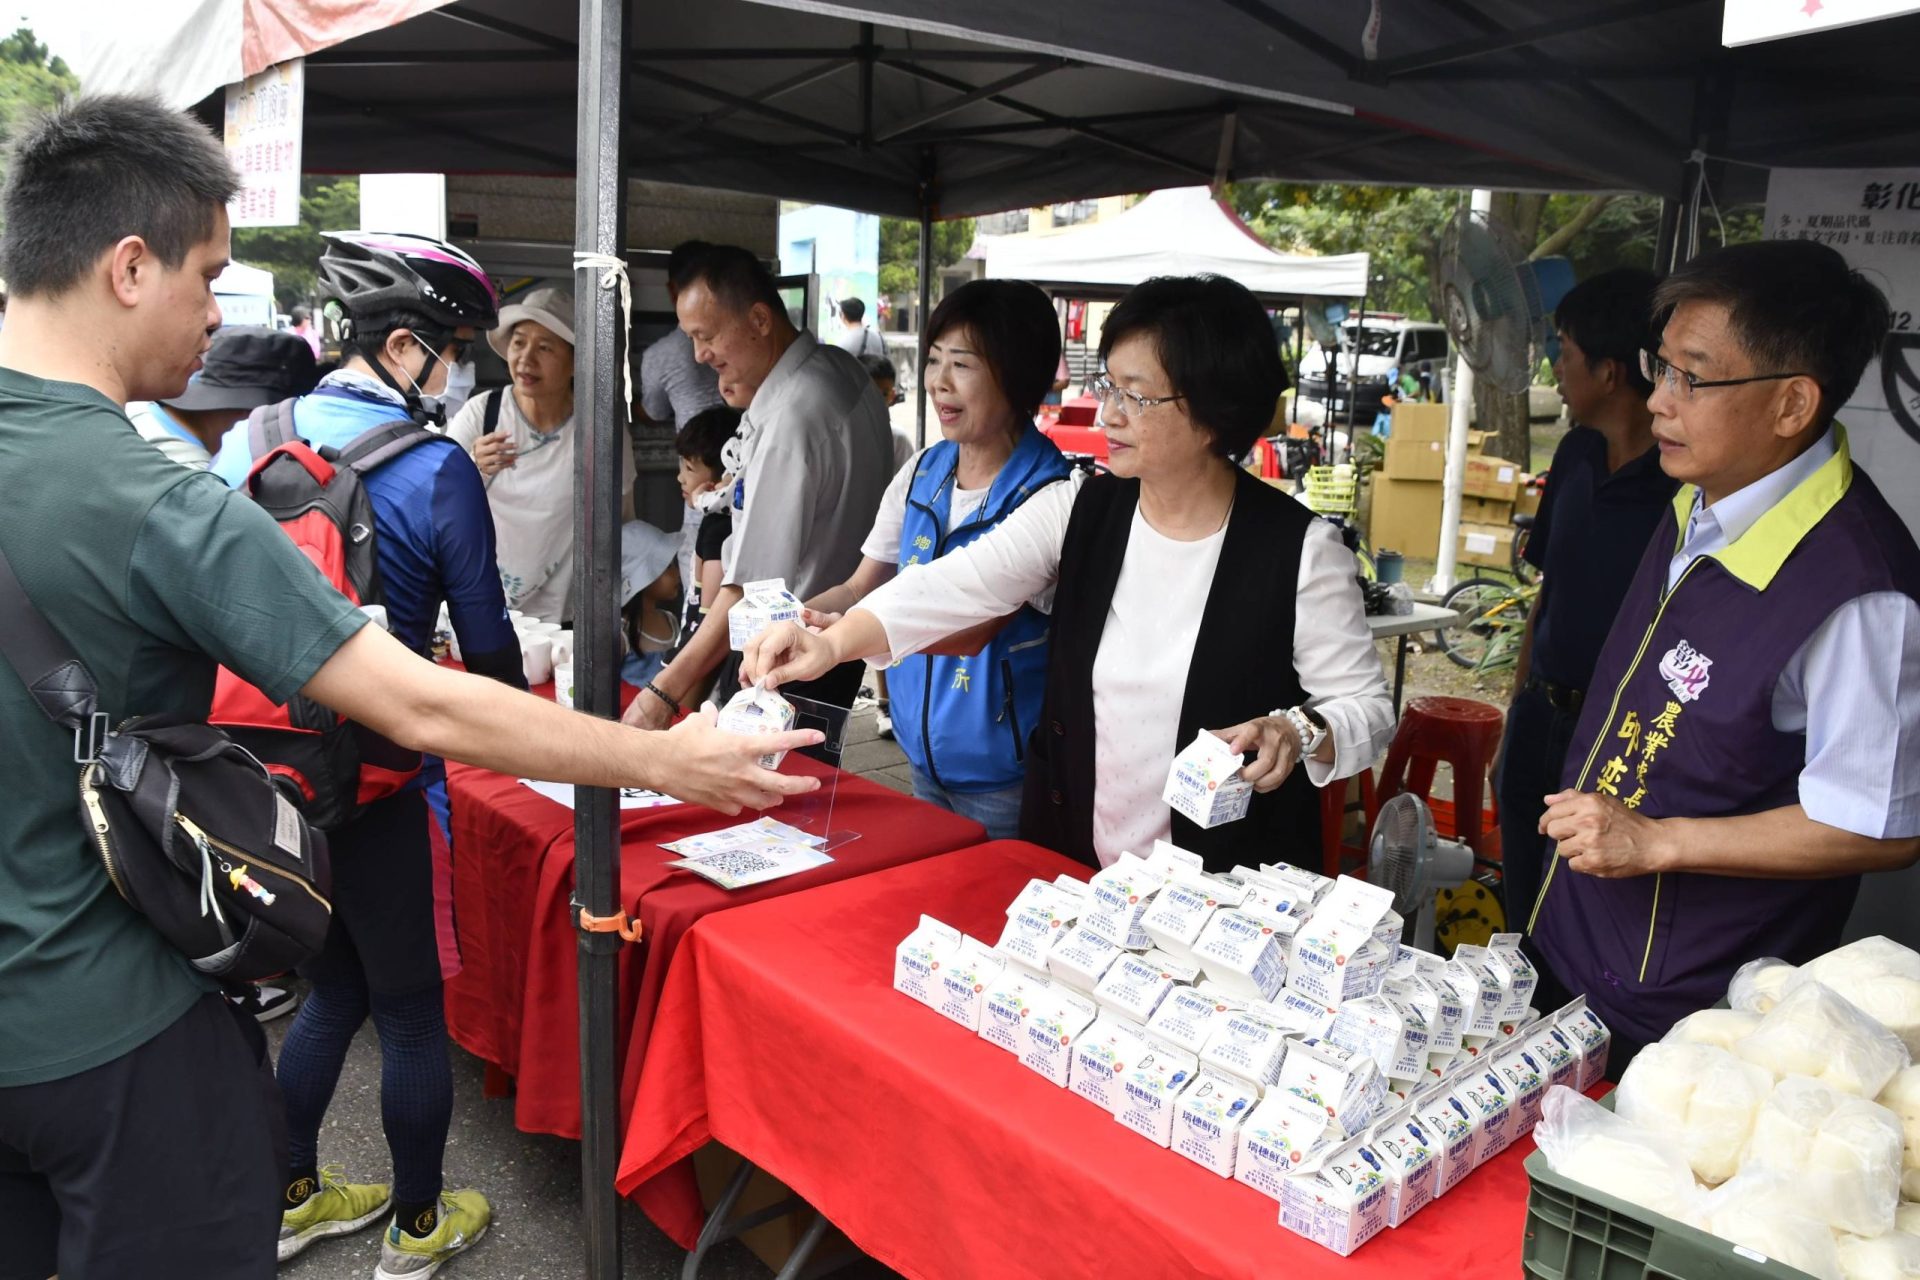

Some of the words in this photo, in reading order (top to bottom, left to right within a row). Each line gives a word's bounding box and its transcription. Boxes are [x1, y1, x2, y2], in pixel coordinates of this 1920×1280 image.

[1861, 182, 1920, 210] 彰化
[1094, 886, 1127, 911] 瑞穗鮮乳
[1167, 890, 1204, 911] 瑞穗鮮乳
[1017, 913, 1049, 934] 瑞穗鮮乳
[1220, 917, 1260, 940] 瑞穗鮮乳
[902, 956, 931, 976] 瑞穗鮮乳
[1299, 947, 1336, 972] 瑞穗鮮乳
[1122, 961, 1159, 984] 瑞穗鮮乳
[943, 976, 974, 999] 瑞穗鮮乳
[988, 1002, 1021, 1025] 瑞穗鮮乳
[1175, 995, 1214, 1017] 瑞穗鮮乳
[1285, 995, 1325, 1018] 瑞穗鮮乳
[1028, 1026, 1060, 1051] 瑞穗鮮乳
[1228, 1019, 1268, 1041] 瑞穗鮮乳
[1079, 1053, 1114, 1079] 瑞穗鮮乳
[1125, 1082, 1161, 1109] 瑞穗鮮乳
[1182, 1110, 1221, 1138] 瑞穗鮮乳
[1248, 1140, 1290, 1170] 瑞穗鮮乳
[1357, 1186, 1386, 1212] 瑞穗鮮乳
